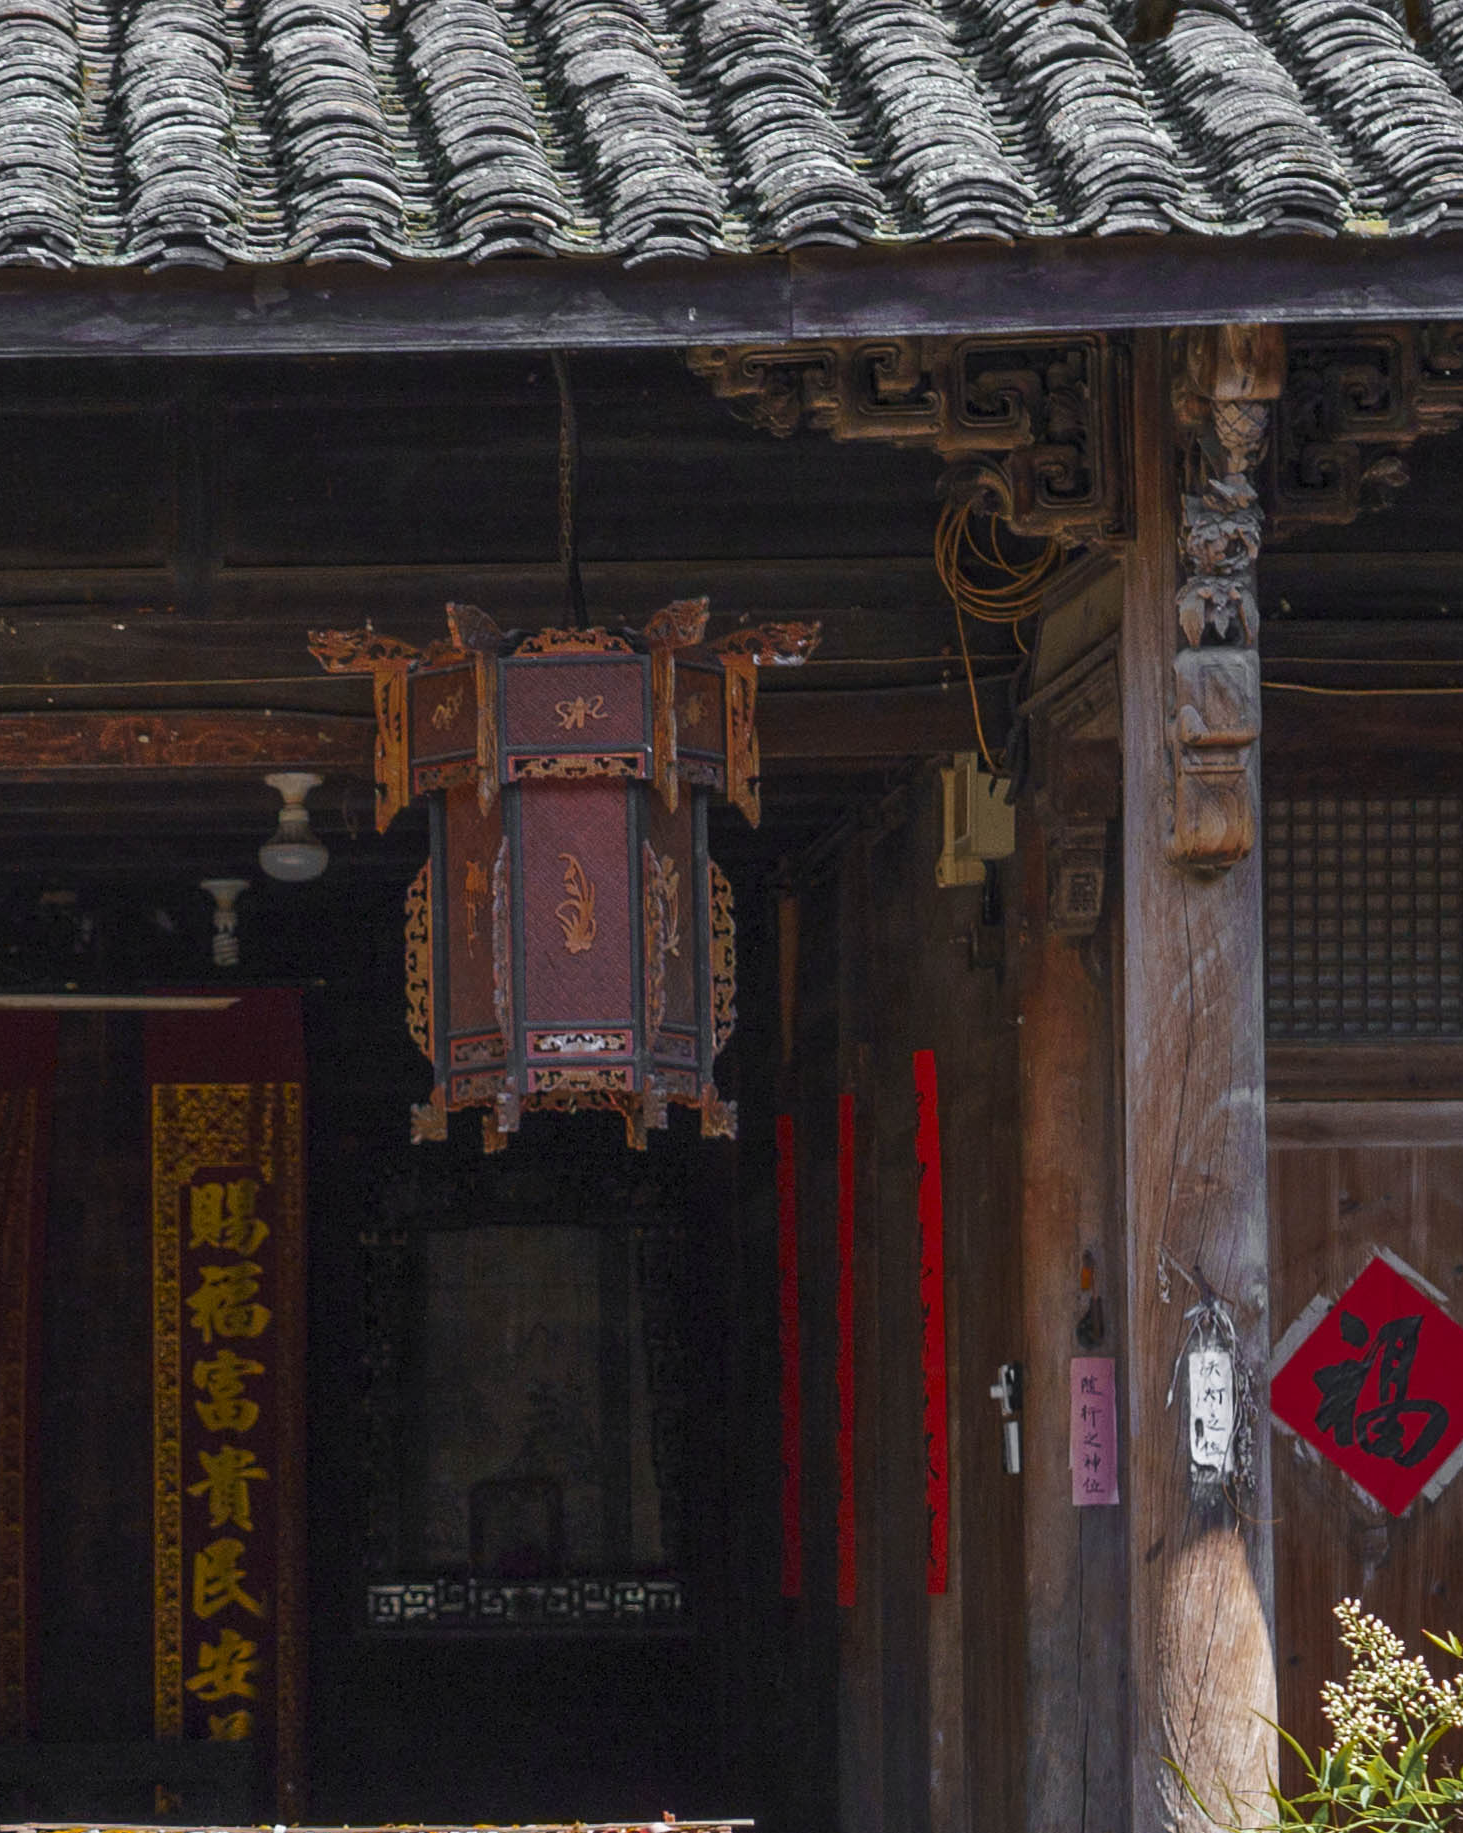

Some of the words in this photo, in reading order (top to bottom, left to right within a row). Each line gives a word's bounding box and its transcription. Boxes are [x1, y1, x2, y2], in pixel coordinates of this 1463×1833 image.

[185, 1178, 272, 1740] 賜福富貴民安
[1312, 1310, 1449, 1468] 福
